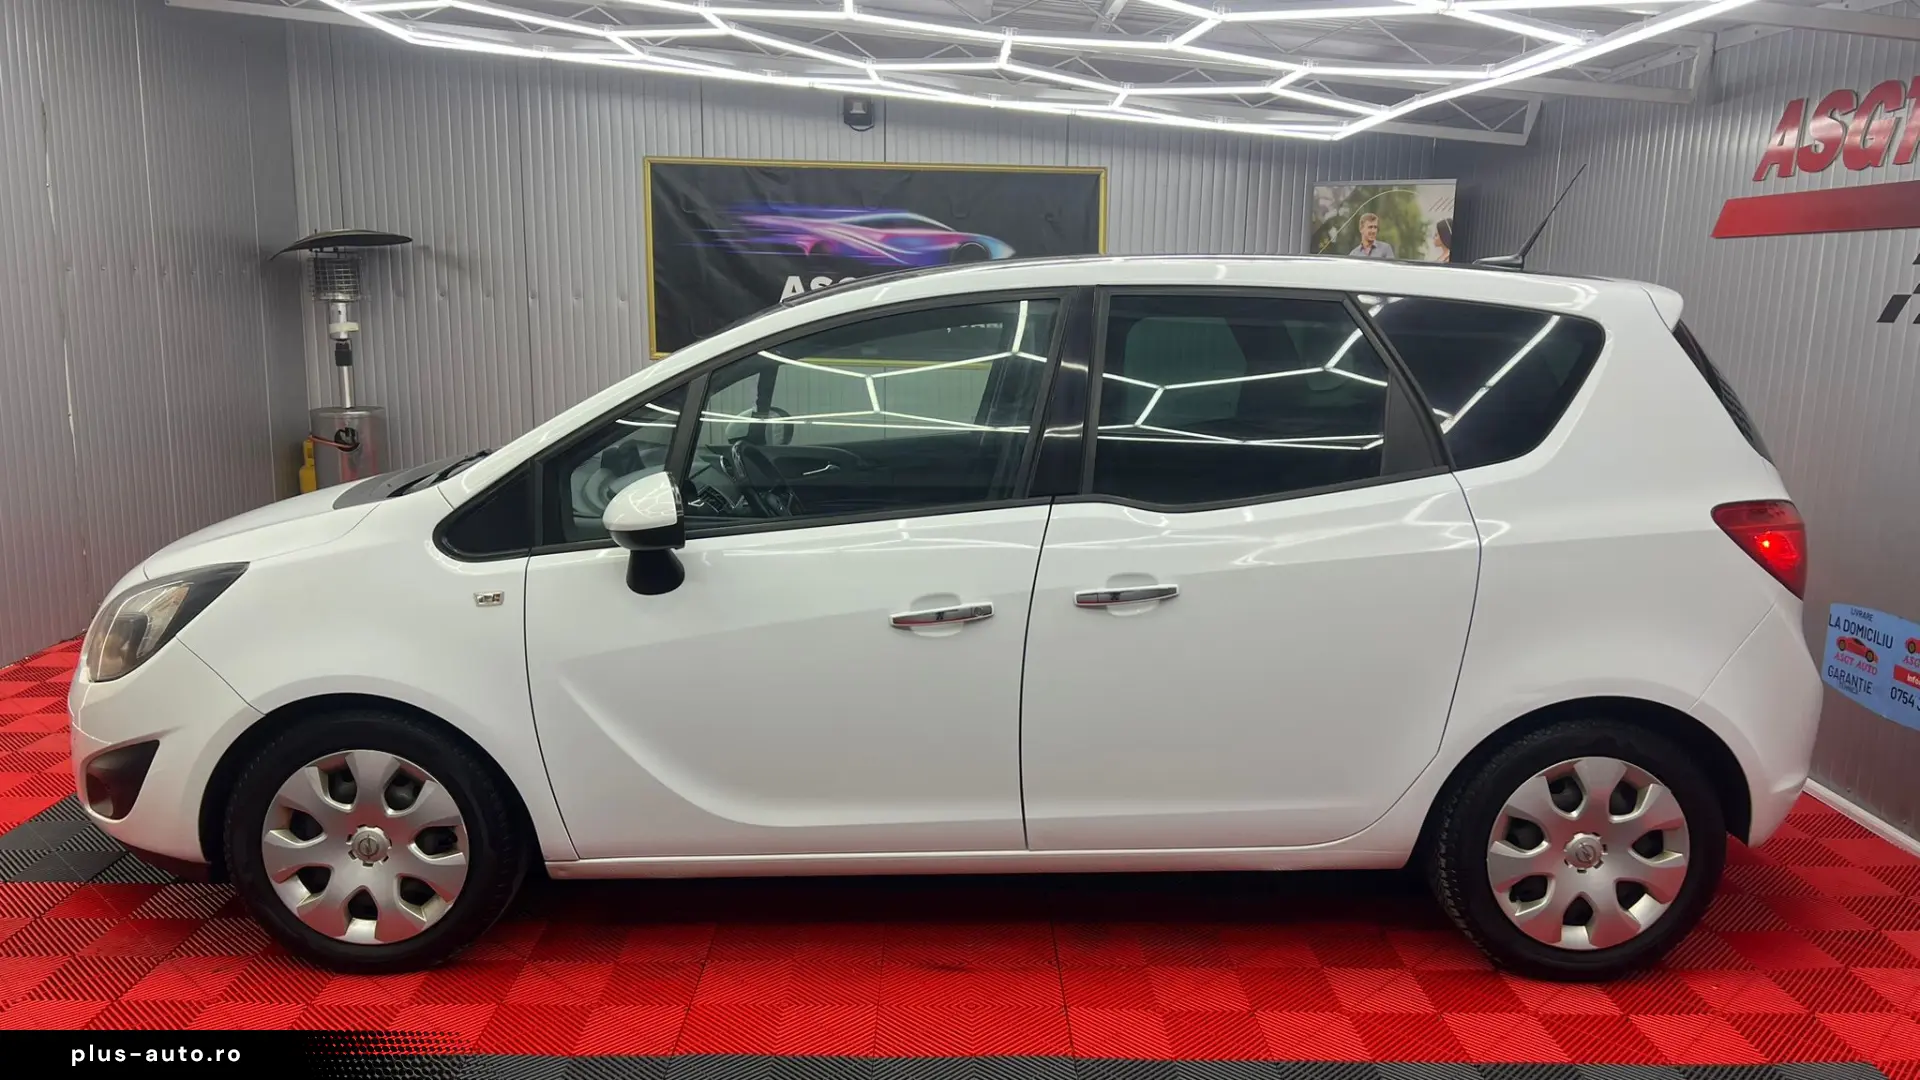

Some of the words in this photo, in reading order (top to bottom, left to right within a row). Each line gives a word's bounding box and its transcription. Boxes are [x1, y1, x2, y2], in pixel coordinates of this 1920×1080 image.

[1828, 613, 1841, 630] LA
[1843, 619, 1894, 649] DOMICILIU
[1827, 665, 1873, 695] GARANTIE
[1856, 660, 1878, 676] AUTO
[1890, 686, 1915, 708] 0754
